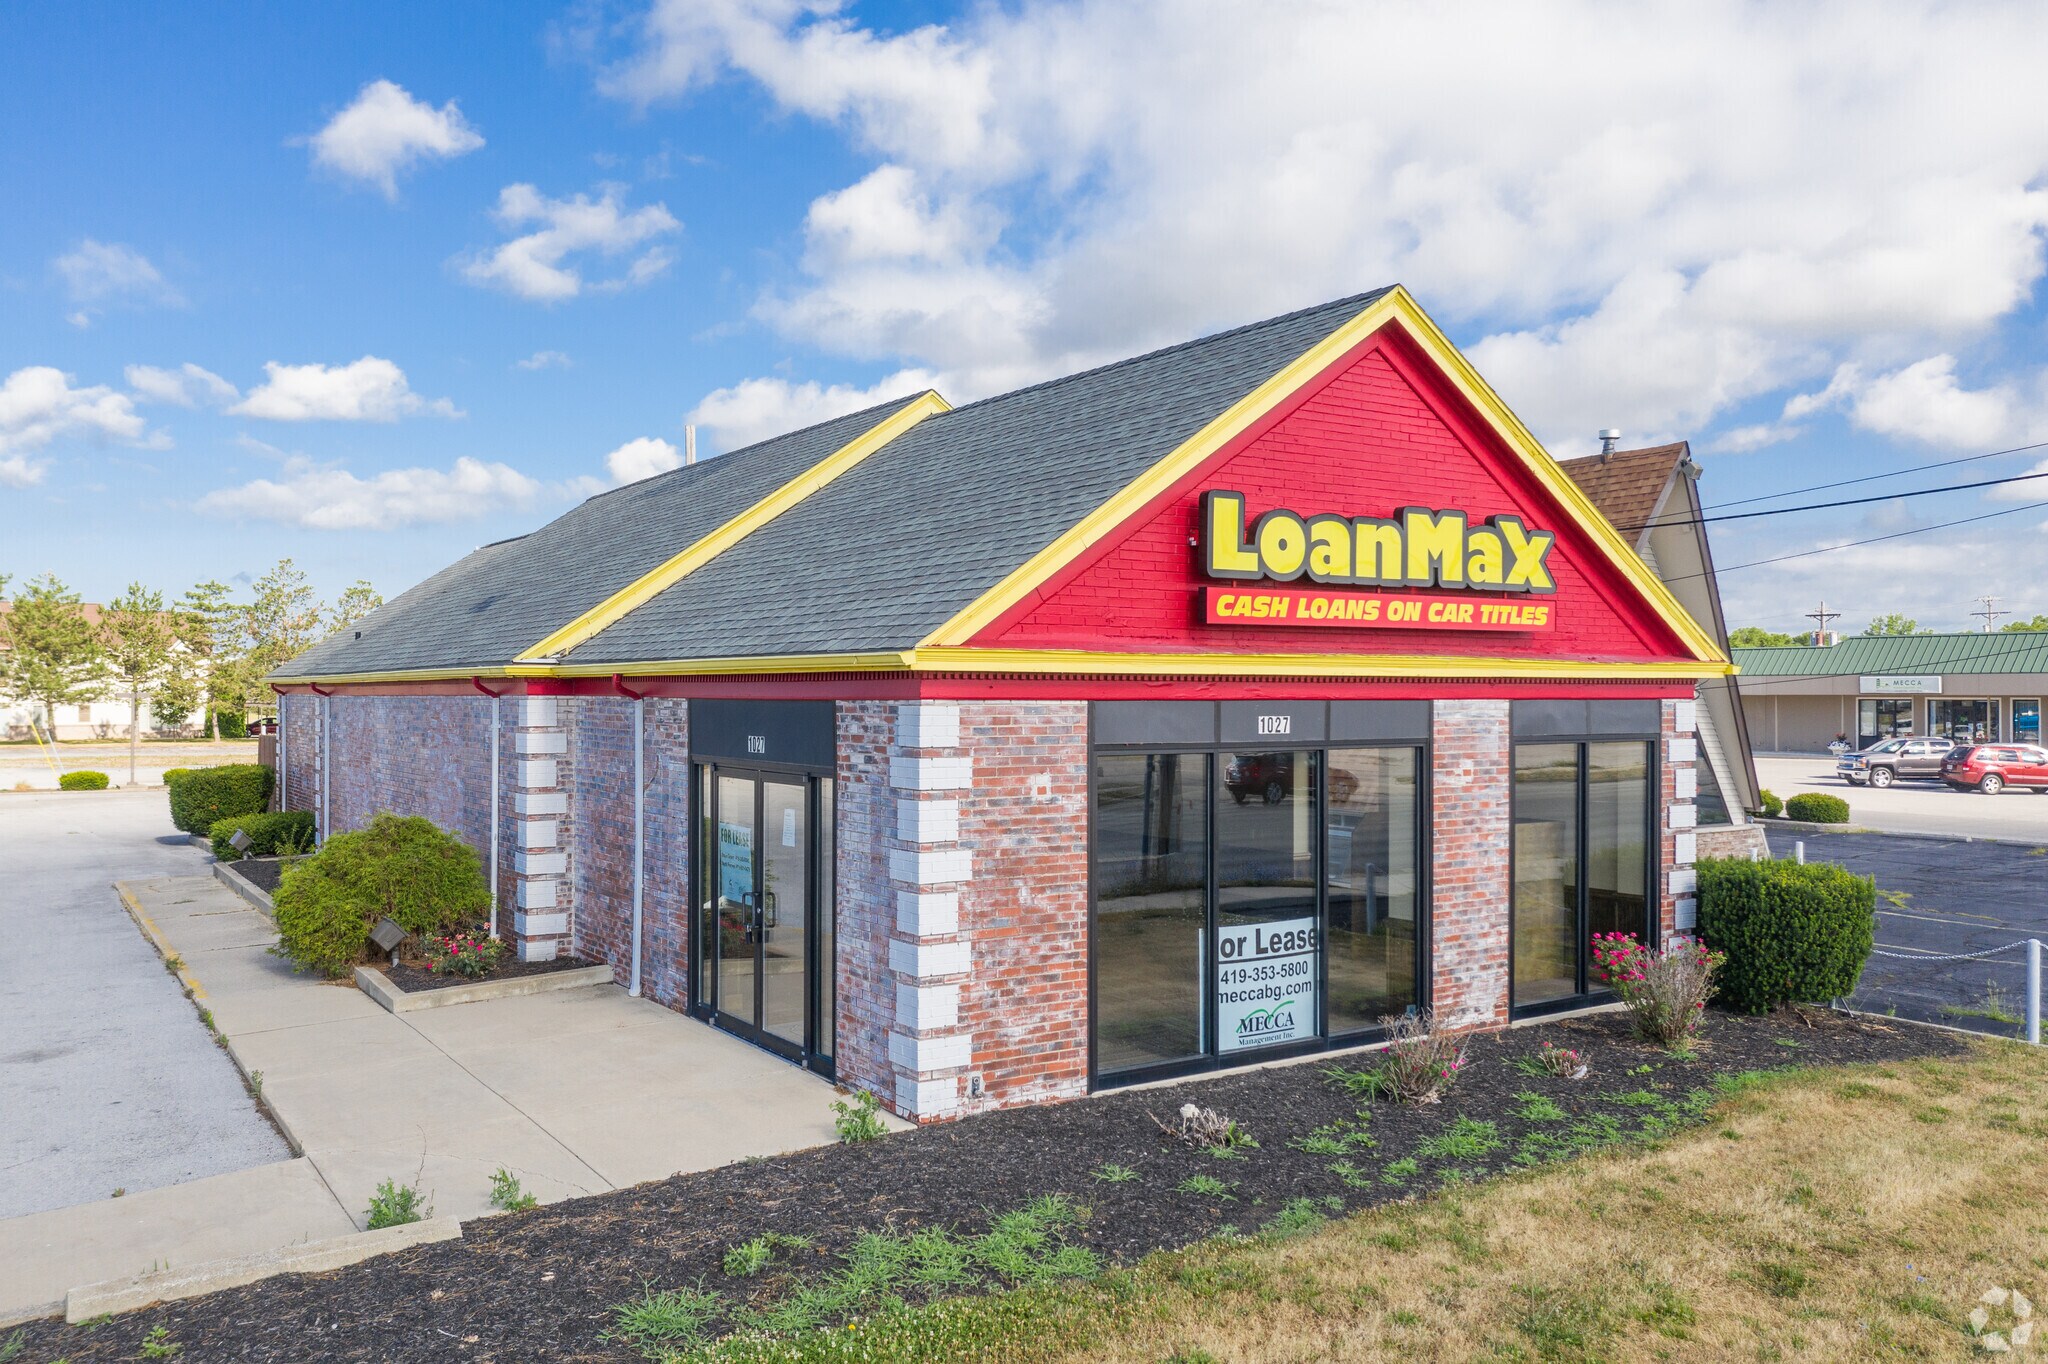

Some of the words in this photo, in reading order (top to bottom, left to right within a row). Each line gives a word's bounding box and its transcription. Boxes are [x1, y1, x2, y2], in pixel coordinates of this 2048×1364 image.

[1216, 595, 1290, 618] CASH
[1296, 597, 1380, 621] LOANS
[1387, 601, 1422, 622] ON
[1427, 603, 1473, 623] CAR
[1480, 605, 1548, 625] TITLES
[1260, 717, 1288, 733] 1027
[749, 736, 764, 752] 1027
[720, 828, 732, 844] FOR
[1220, 936, 1247, 958] or
[1255, 927, 1318, 955] Lease
[1220, 960, 1308, 984] 419-353-5800
[1218, 981, 1312, 1004] meccabg.com
[1239, 1011, 1295, 1034] MECCA
[1238, 1034, 1282, 1046] Management
